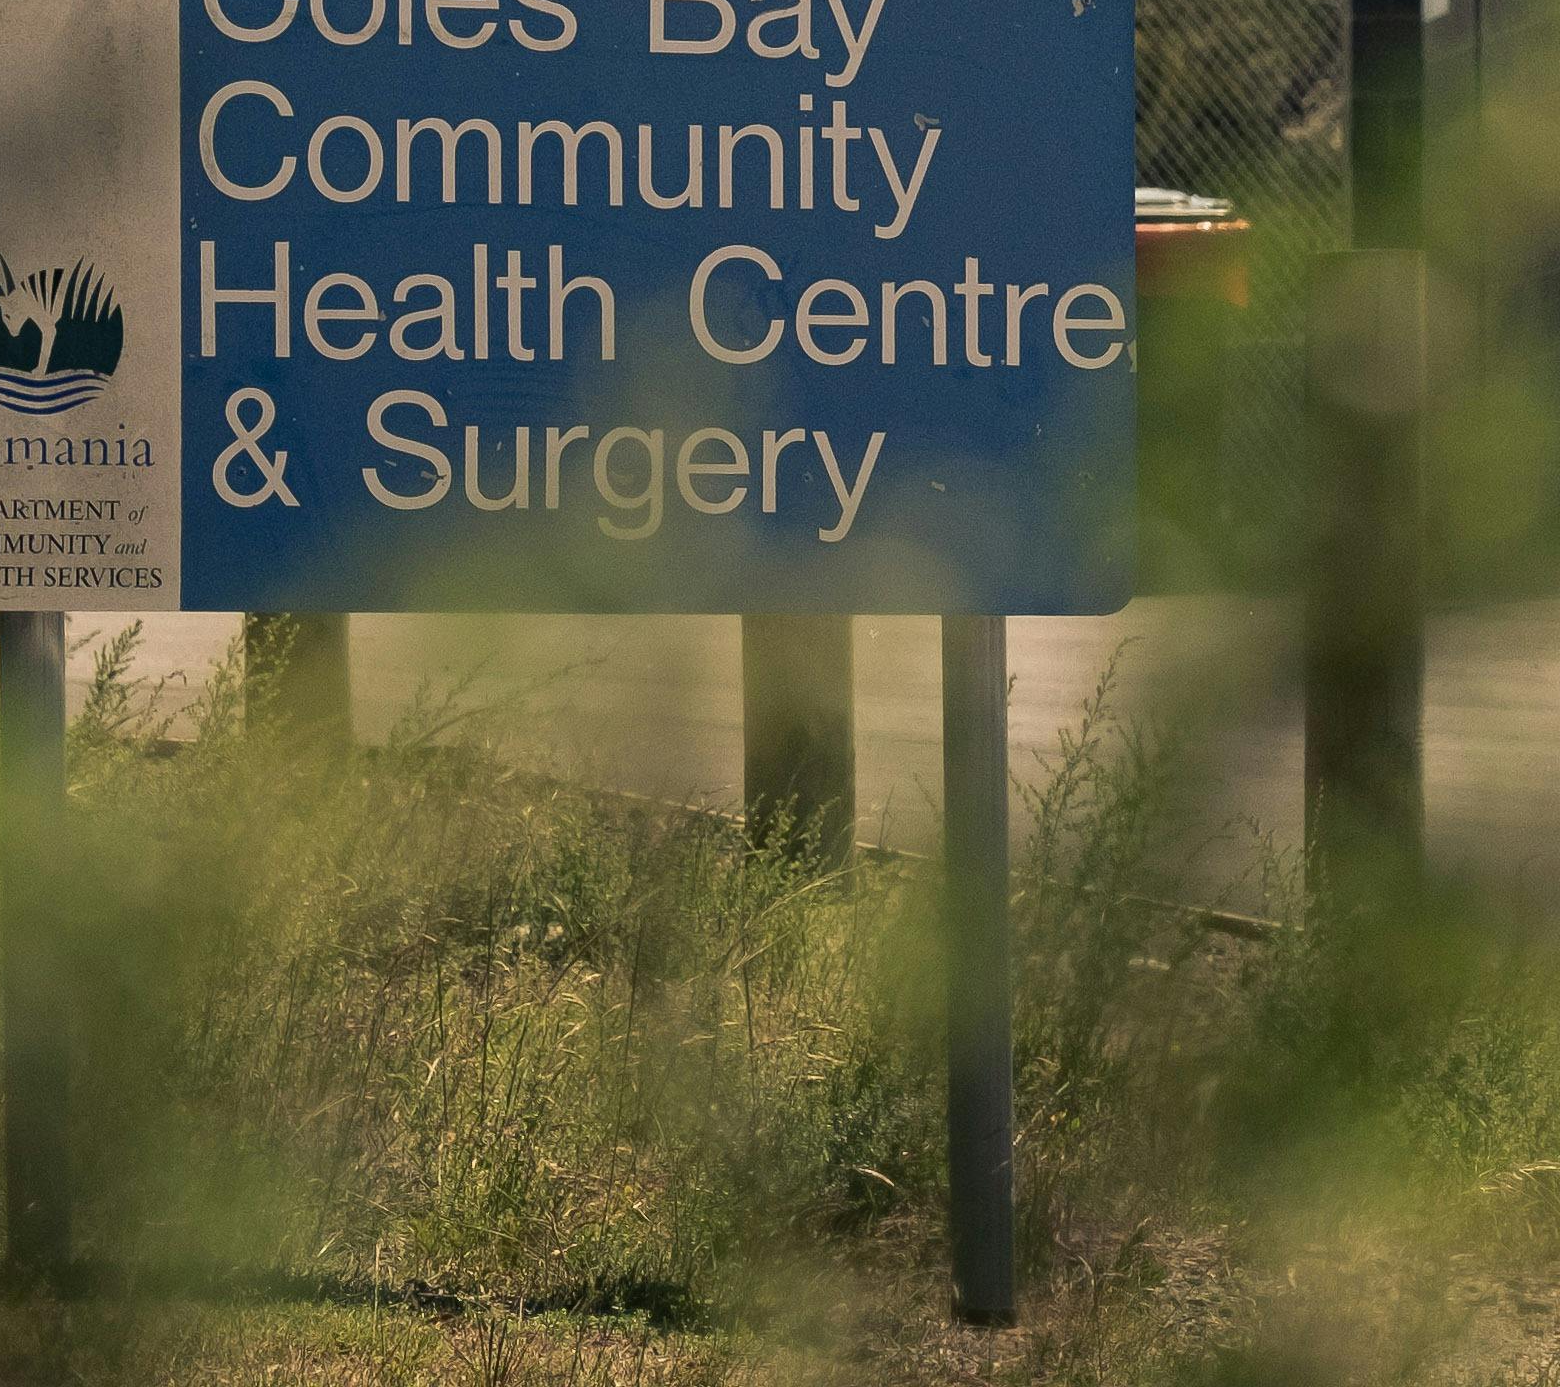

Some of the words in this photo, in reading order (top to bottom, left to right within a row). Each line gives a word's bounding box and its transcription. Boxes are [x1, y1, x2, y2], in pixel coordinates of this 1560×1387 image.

[197, 79, 943, 240] Community
[198, 240, 618, 362] Health
[688, 243, 1127, 370] Centre
[211, 386, 301, 509] &
[361, 387, 888, 543] Surgery
[114, 537, 148, 556] and
[127, 505, 149, 525] of
[43, 566, 163, 589] SERVICES
